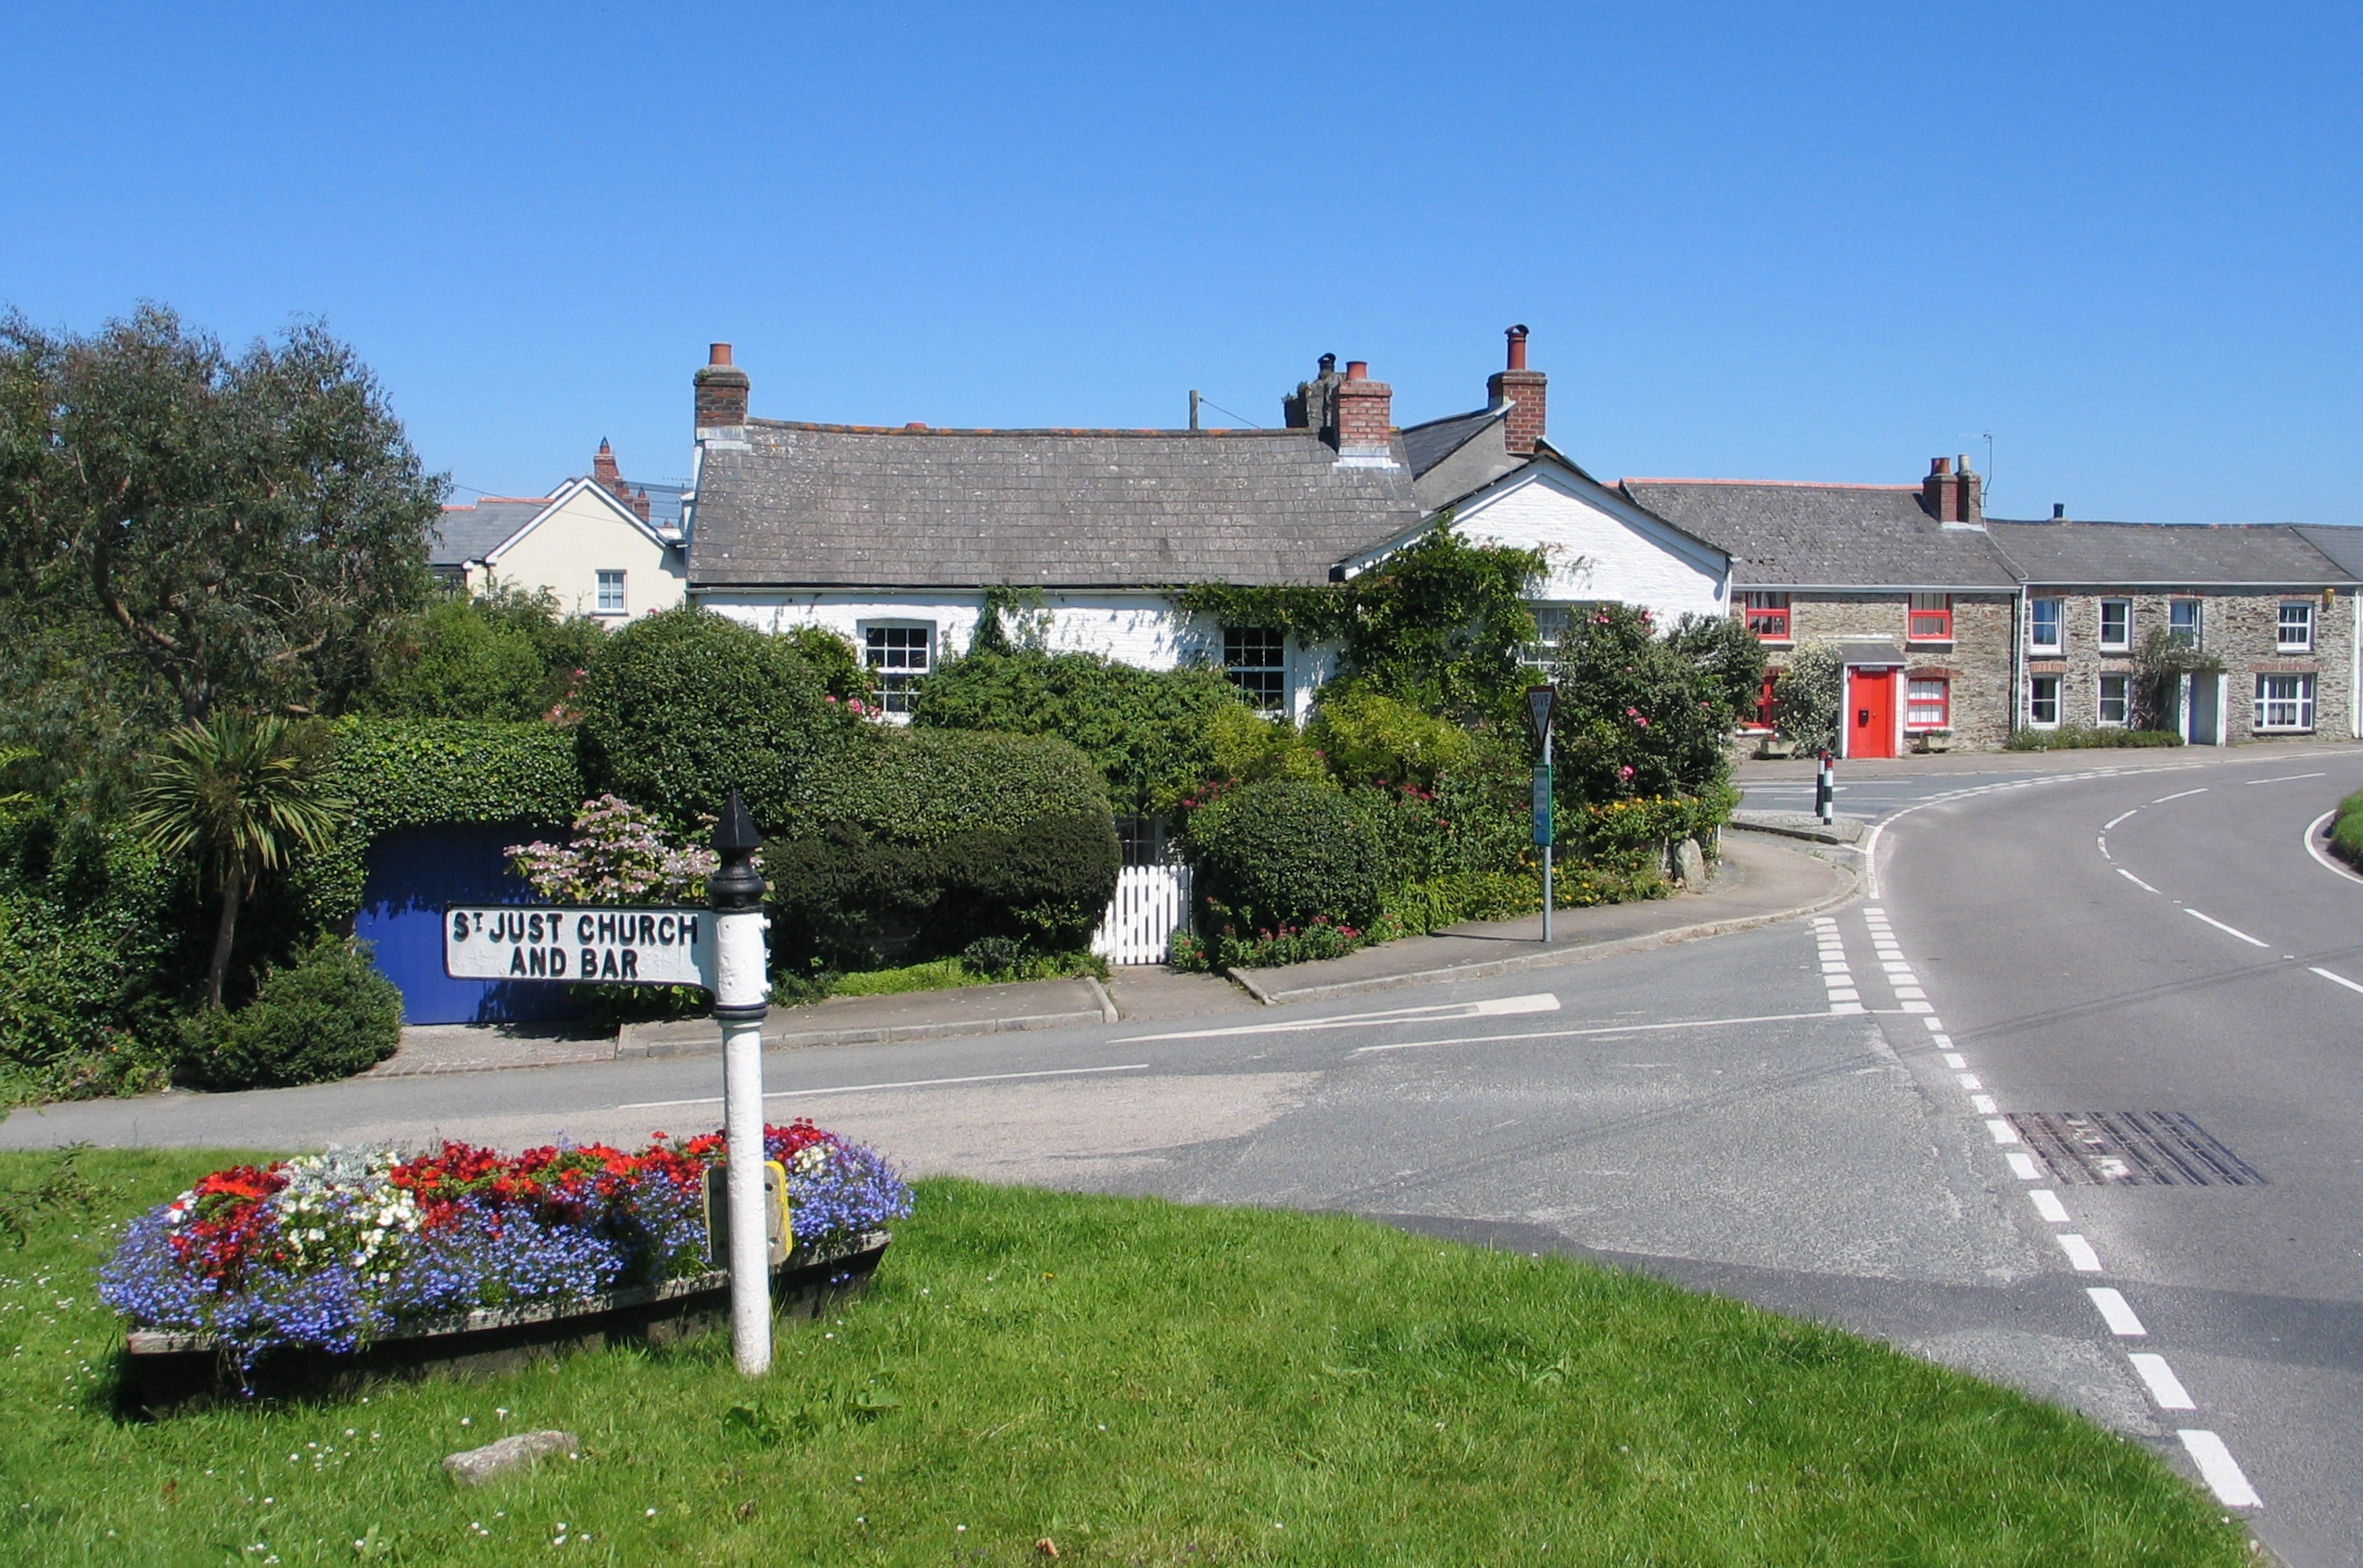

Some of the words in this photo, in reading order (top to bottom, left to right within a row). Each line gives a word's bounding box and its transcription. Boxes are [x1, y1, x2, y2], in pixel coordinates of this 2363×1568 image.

[1532, 693, 1548, 706] GIVE
[489, 912, 563, 942] JUST
[577, 913, 698, 945] CHURCH
[510, 946, 567, 977] AND
[581, 947, 638, 979] BAR
